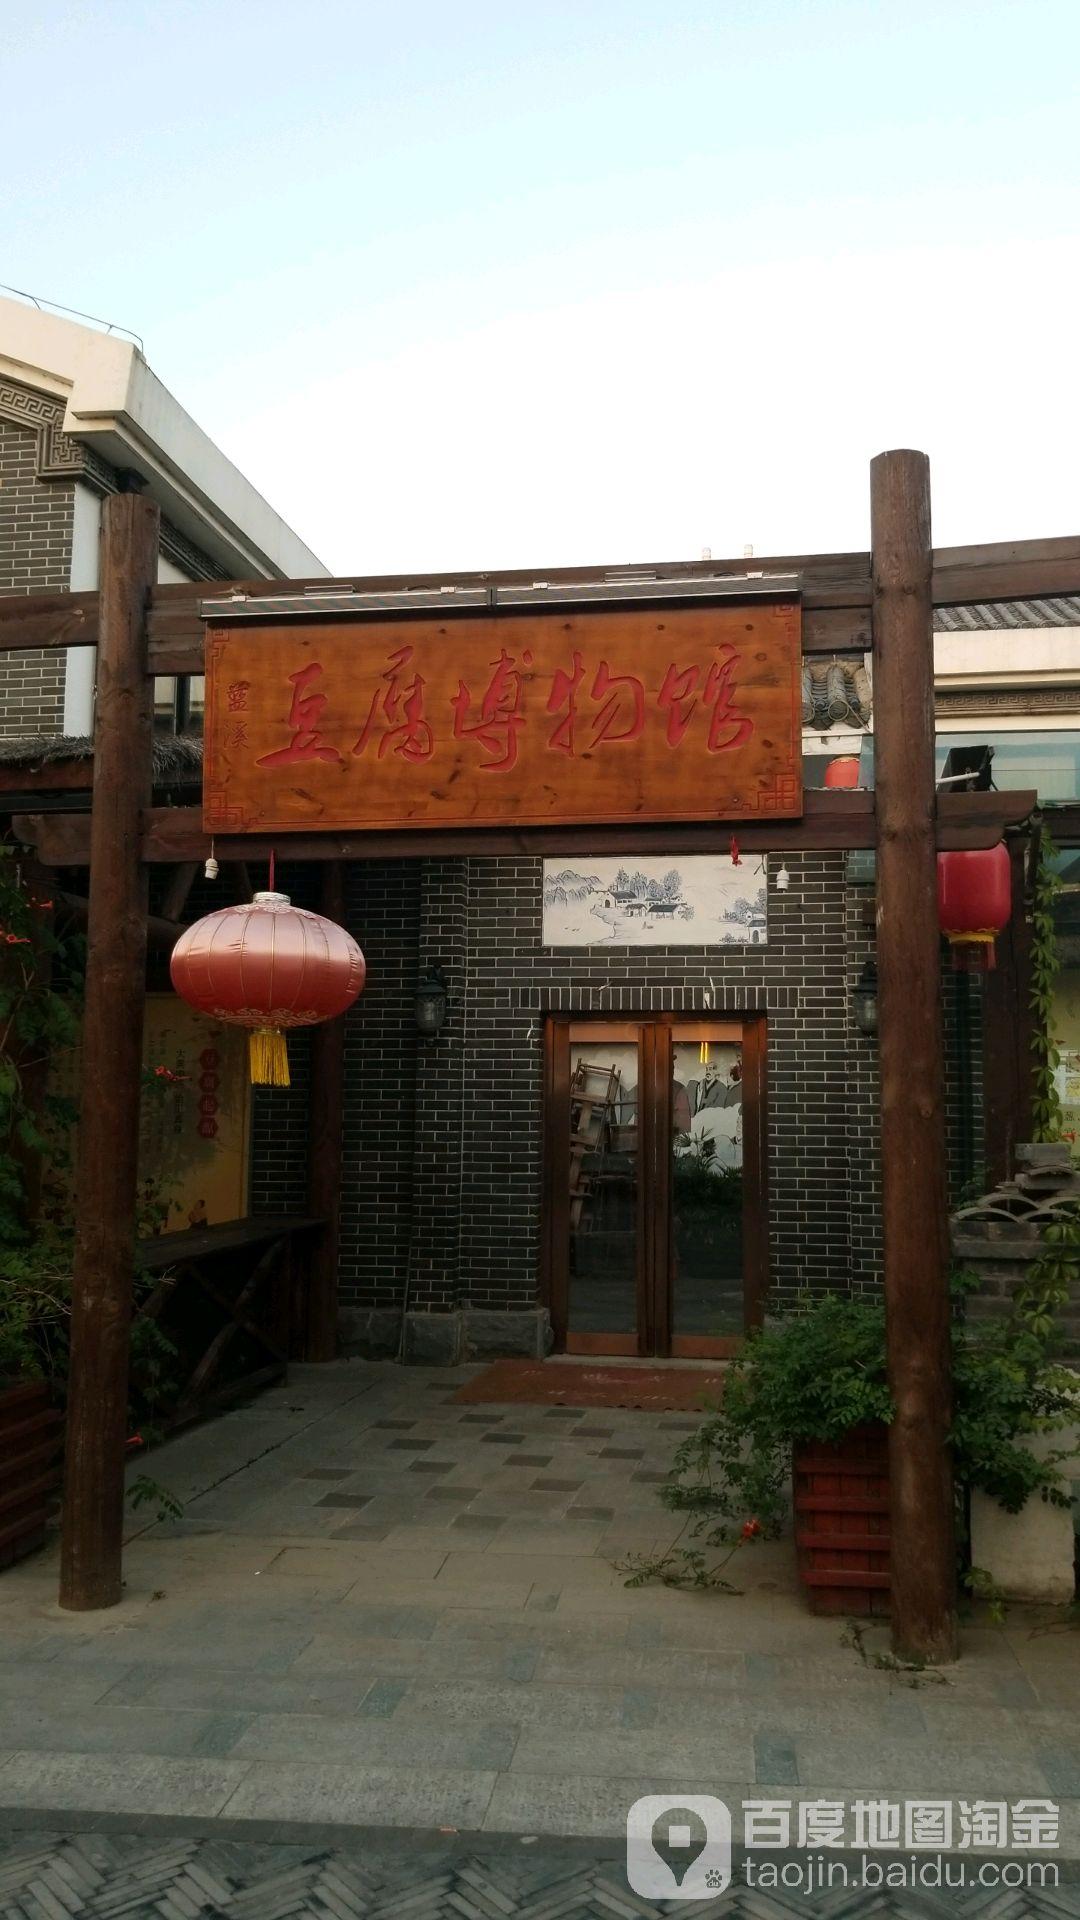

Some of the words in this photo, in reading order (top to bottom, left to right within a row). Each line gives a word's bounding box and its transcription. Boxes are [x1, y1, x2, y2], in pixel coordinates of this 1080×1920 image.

[255, 645, 755, 773] 豆腐博物馆
